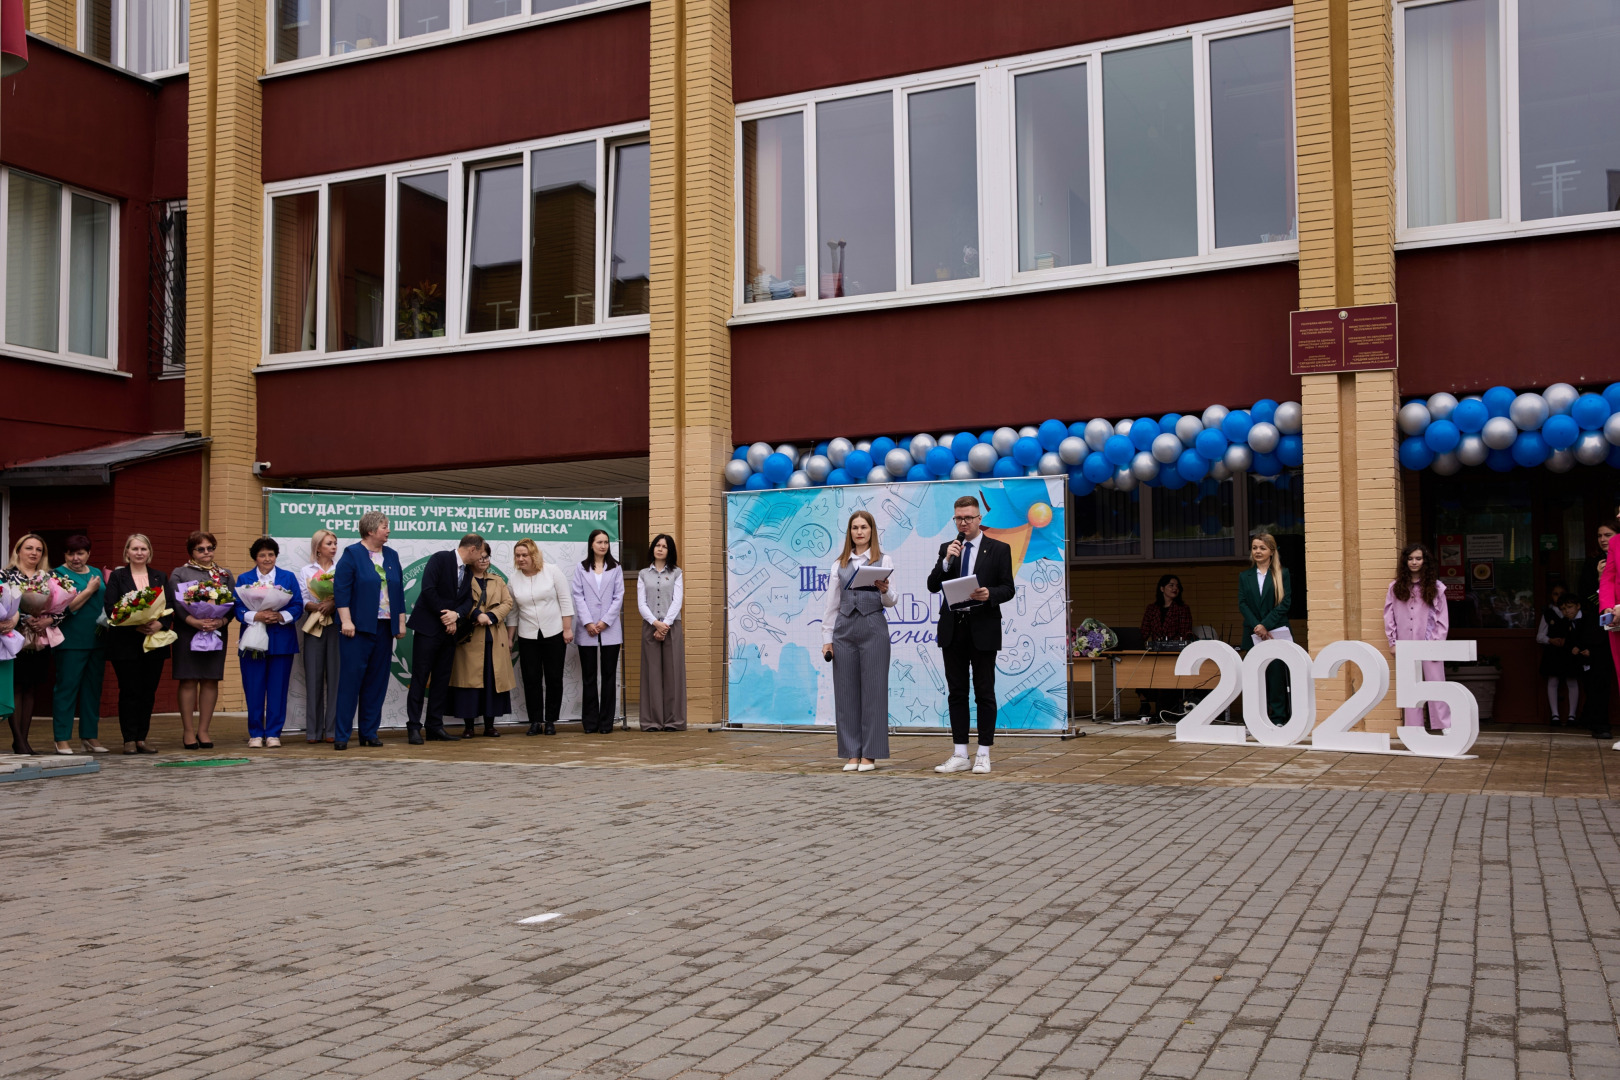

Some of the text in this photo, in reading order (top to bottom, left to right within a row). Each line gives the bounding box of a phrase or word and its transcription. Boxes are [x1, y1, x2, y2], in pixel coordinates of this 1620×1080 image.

[280, 502, 608, 521] ГОСУДАРСТВЕННОЕ УЧРЕЖДЕНИЕ ОБРАЗОВАНИЯ
[320, 519, 573, 534] "СРЕД ШКОЛА № 147 г. МИНСКА"
[1174, 639, 1478, 757] 2025
